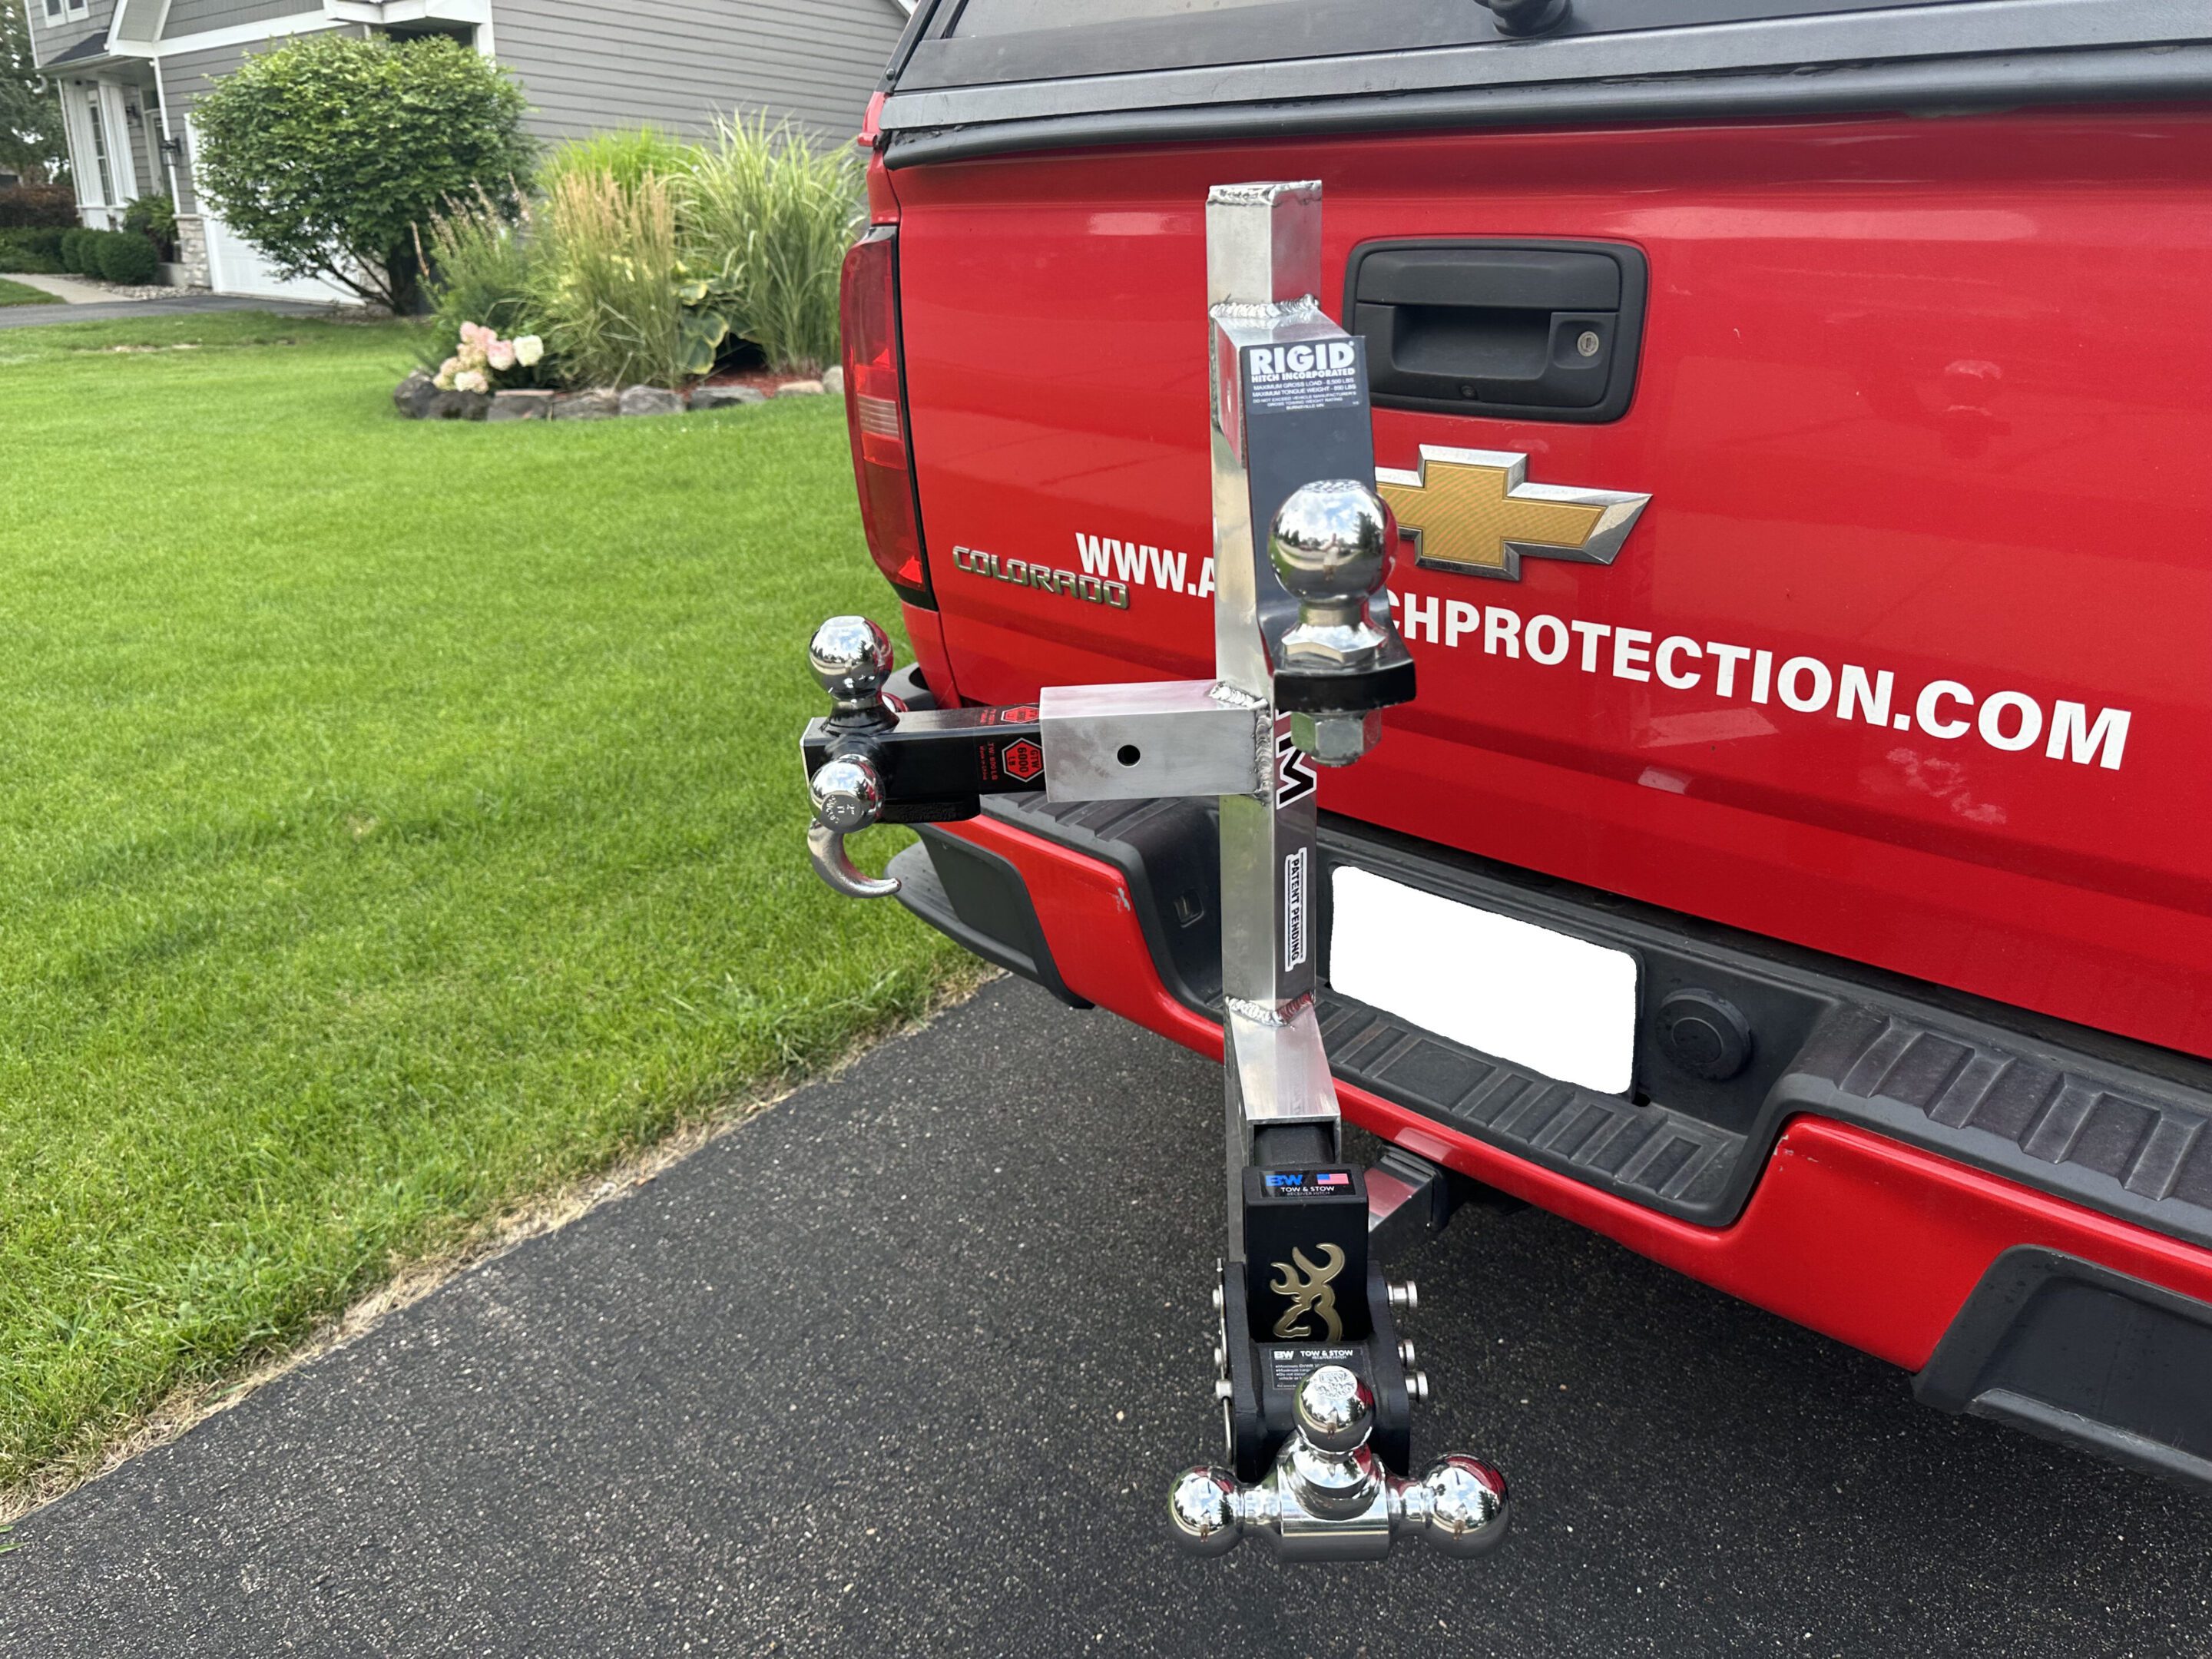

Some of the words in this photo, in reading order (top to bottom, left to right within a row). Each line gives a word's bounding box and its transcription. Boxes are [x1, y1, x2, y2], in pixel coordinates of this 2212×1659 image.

[1250, 342, 1355, 376] RIGID
[1251, 374, 1280, 383] HITCH
[1282, 367, 1356, 381] INCORPORATED
[952, 545, 1130, 610] COLORADO
[1008, 756, 1016, 766] LB
[1017, 747, 1029, 773] 6000
[1030, 749, 1041, 769] GTW
[1291, 858, 1300, 904] PATENT
[1291, 906, 1300, 962] PENDING
